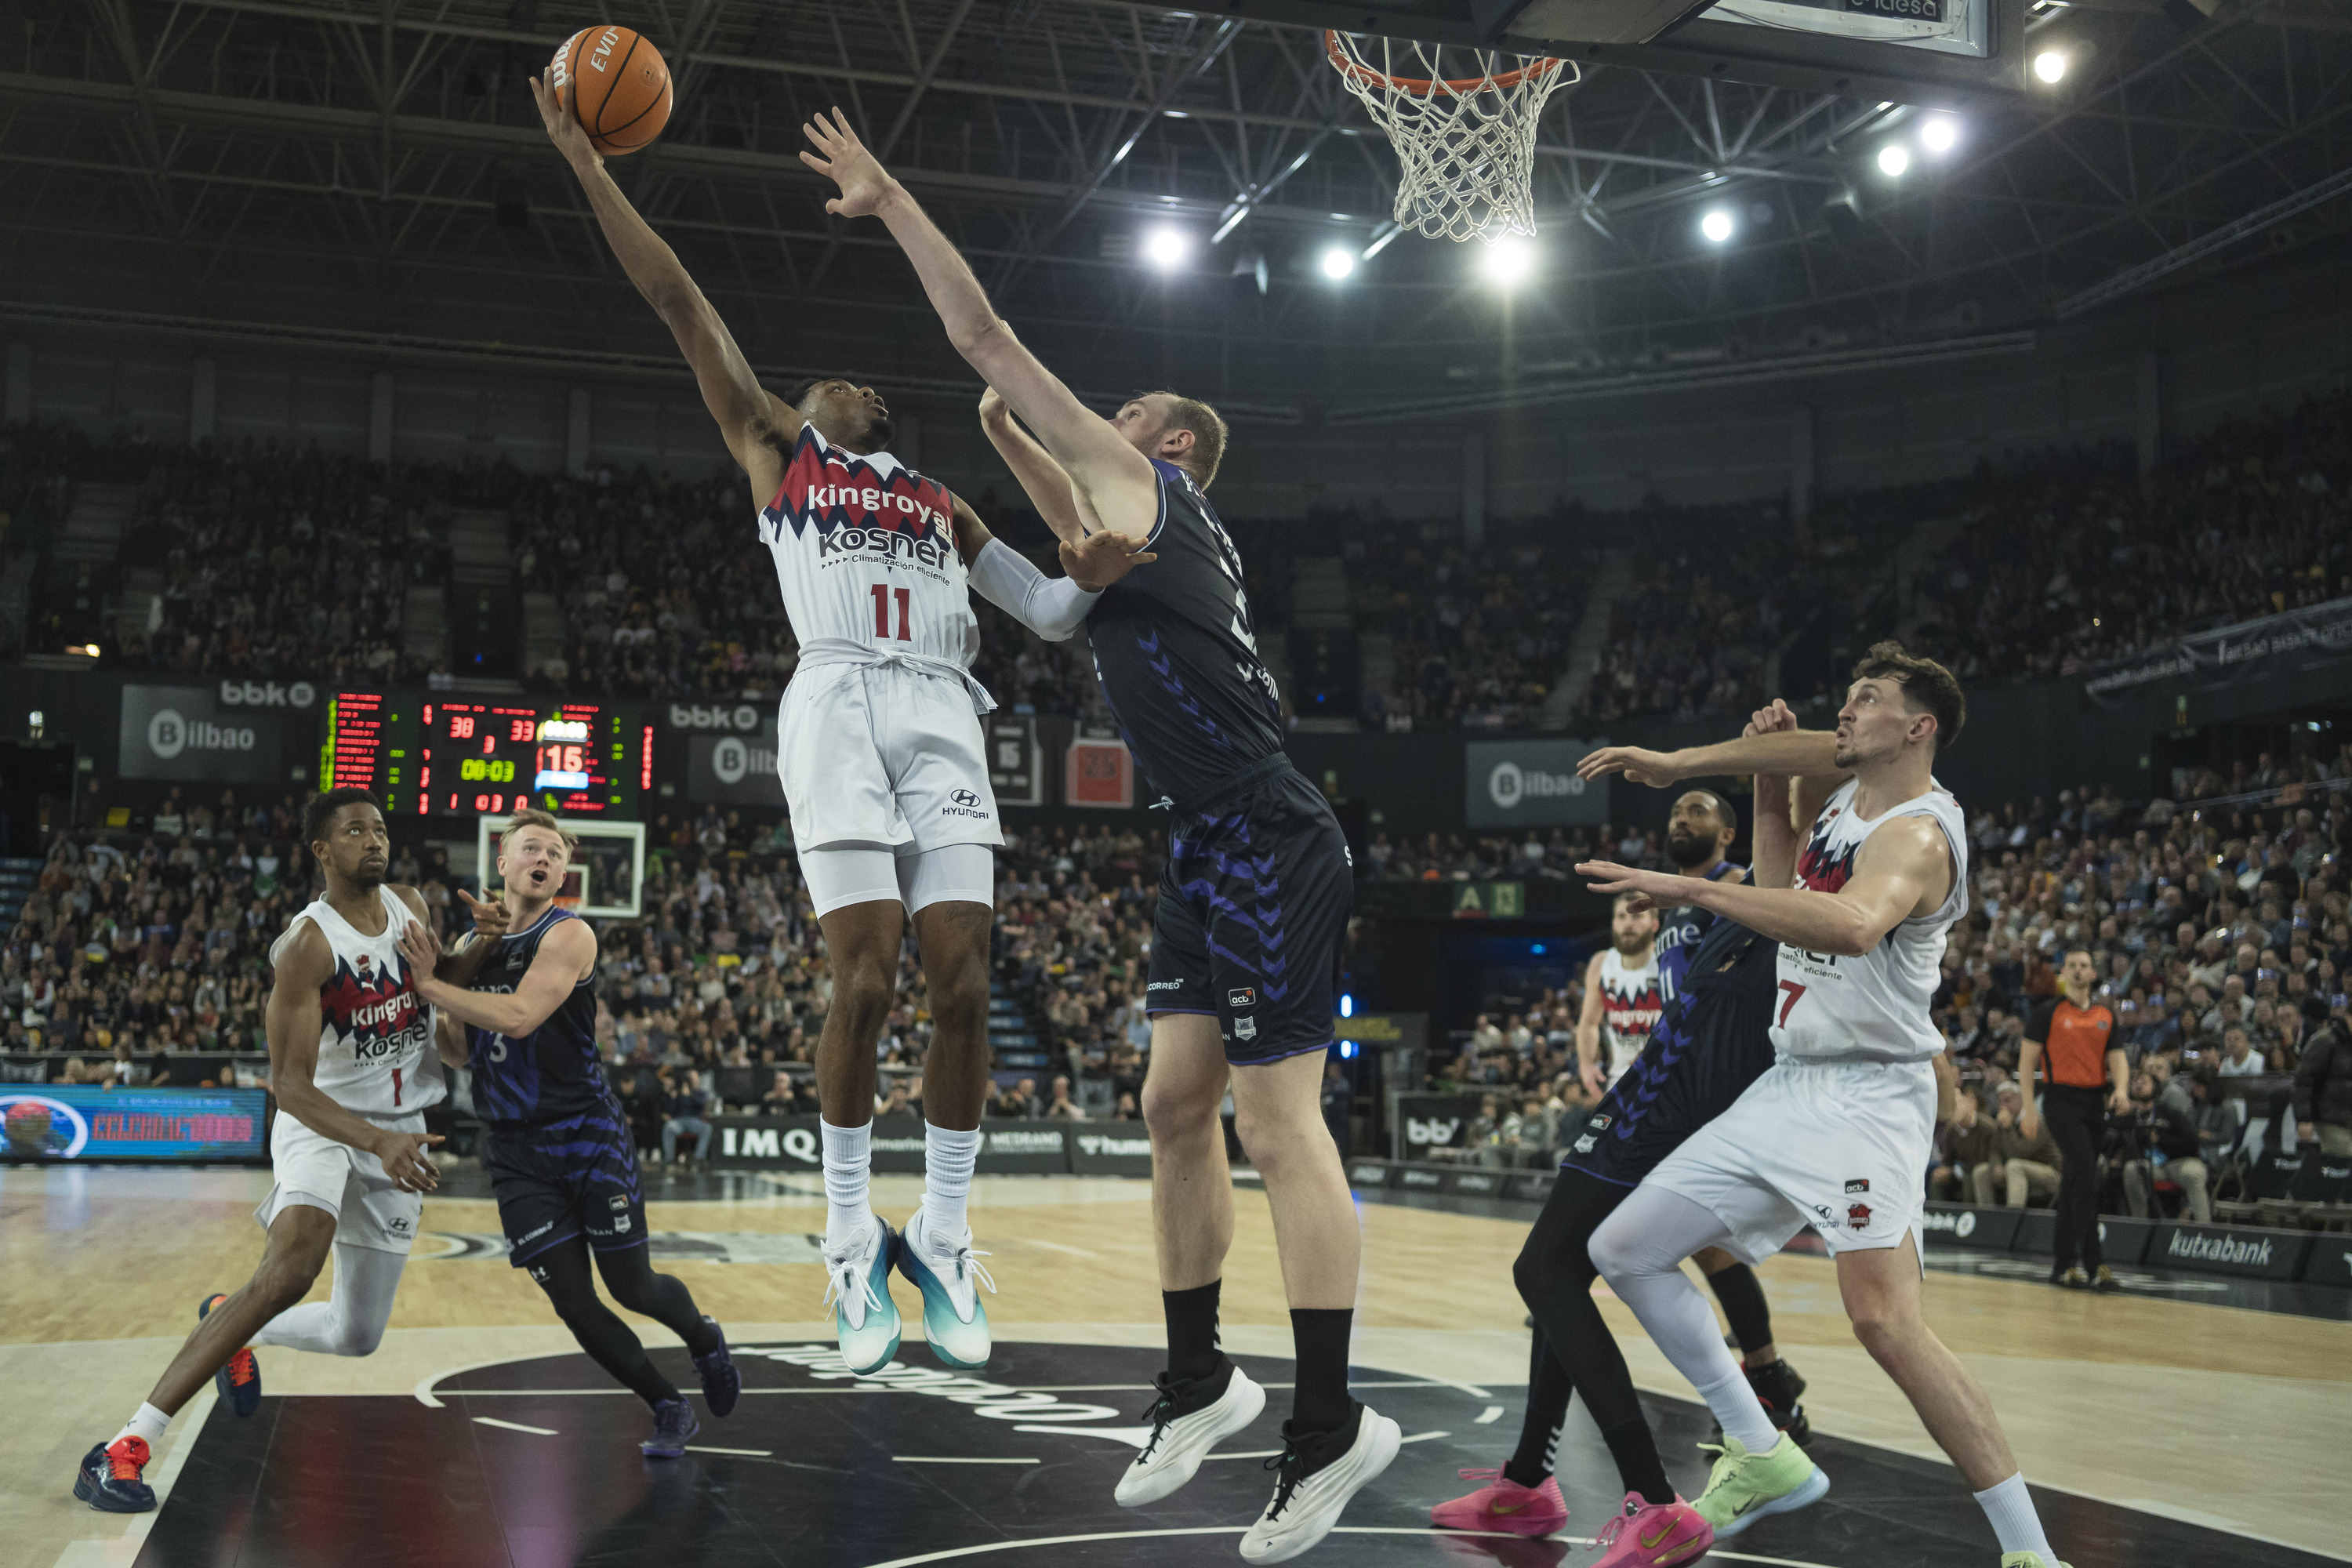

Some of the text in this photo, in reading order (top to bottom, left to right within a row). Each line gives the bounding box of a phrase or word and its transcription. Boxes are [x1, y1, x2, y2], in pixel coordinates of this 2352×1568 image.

[808, 483, 953, 539] kingroyal
[851, 554, 950, 586] Climatización eficiente
[871, 584, 912, 642] 11
[220, 681, 286, 706] bbk
[510, 720, 535, 742] 33
[670, 705, 731, 729] bbk
[149, 710, 255, 756] Bilbao
[546, 745, 583, 772] 15
[942, 808, 989, 819] HYUNDAI
[1148, 982, 1180, 991] CORREO
[1804, 966, 1842, 980] eficiente
[351, 991, 419, 1028] kingro
[1232, 995, 1249, 1004] acb
[1779, 979, 1806, 1029] 7
[489, 1031, 507, 1062] 3
[392, 1069, 402, 1107] 1
[722, 1127, 820, 1163] IMQ
[1846, 1184, 1864, 1192] acb
[2168, 1228, 2273, 1265] kutxabank
